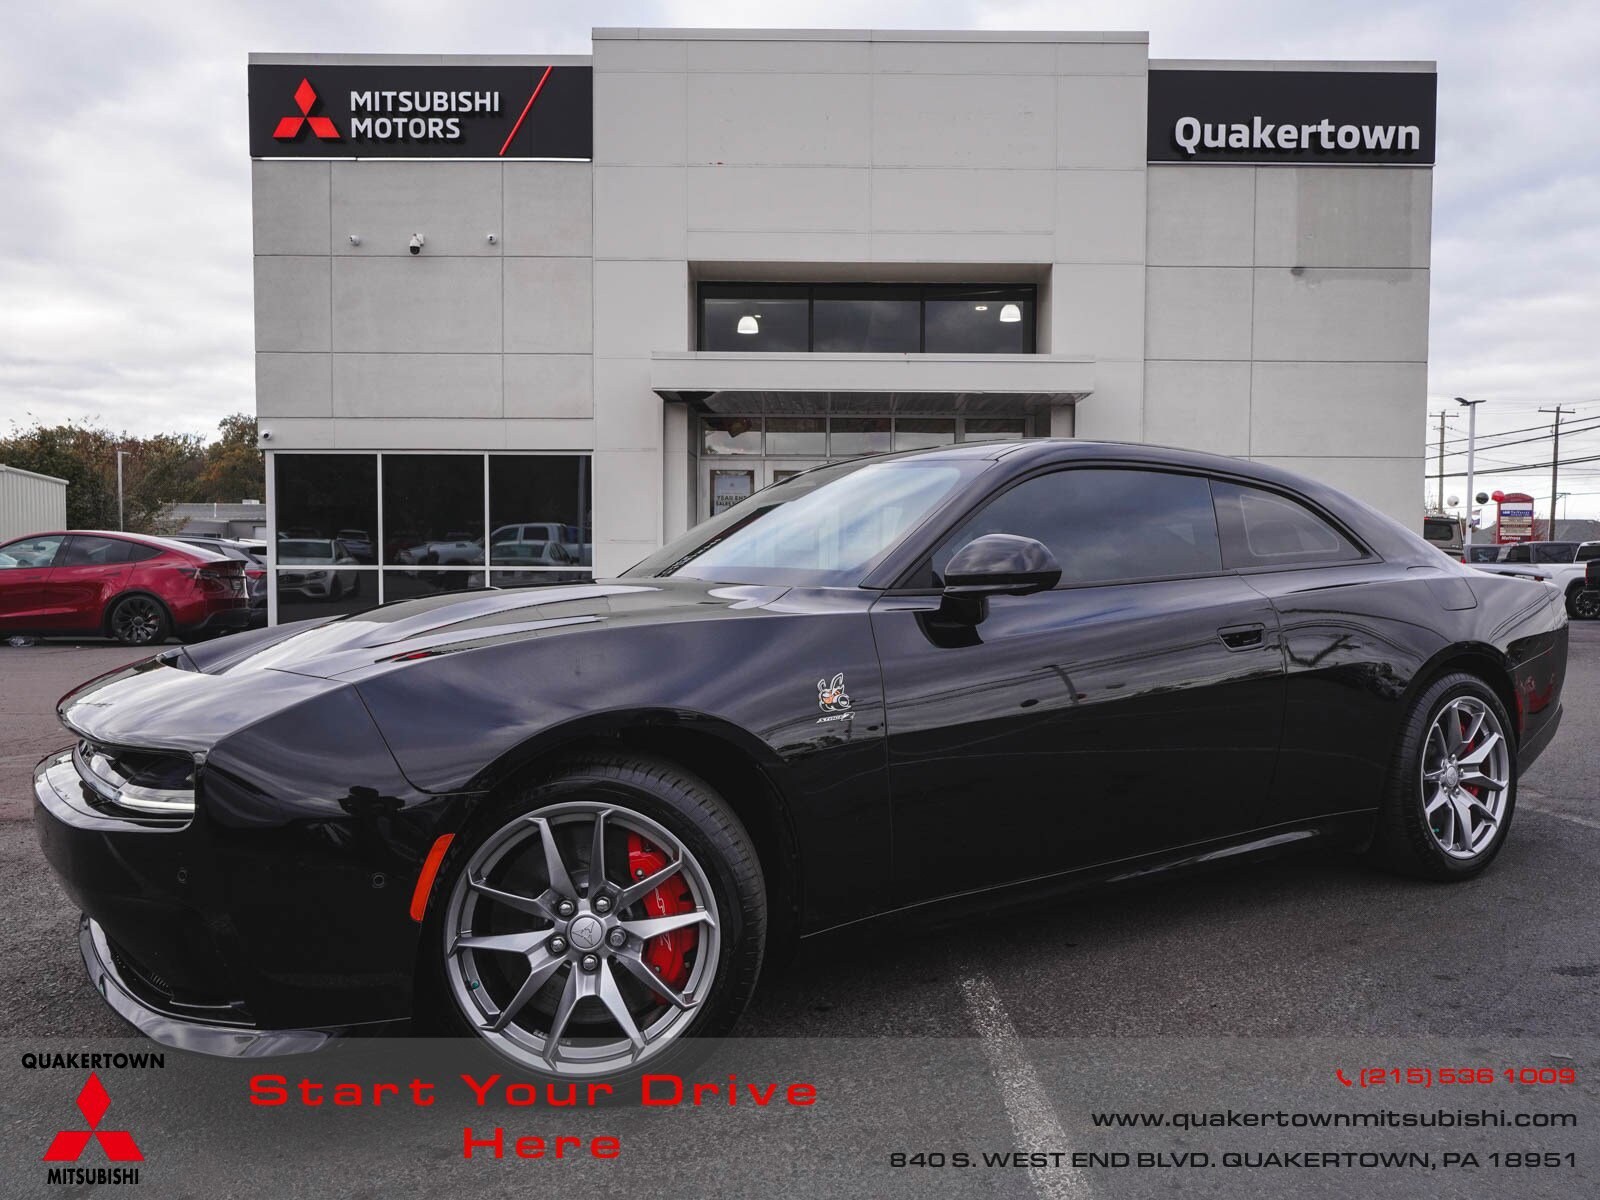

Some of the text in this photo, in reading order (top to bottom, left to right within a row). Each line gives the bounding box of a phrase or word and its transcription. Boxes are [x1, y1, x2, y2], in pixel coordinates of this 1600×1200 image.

[351, 92, 498, 111] MITSUBISHI
[352, 118, 459, 138] MOTORS
[1176, 117, 1419, 153] Quakertown
